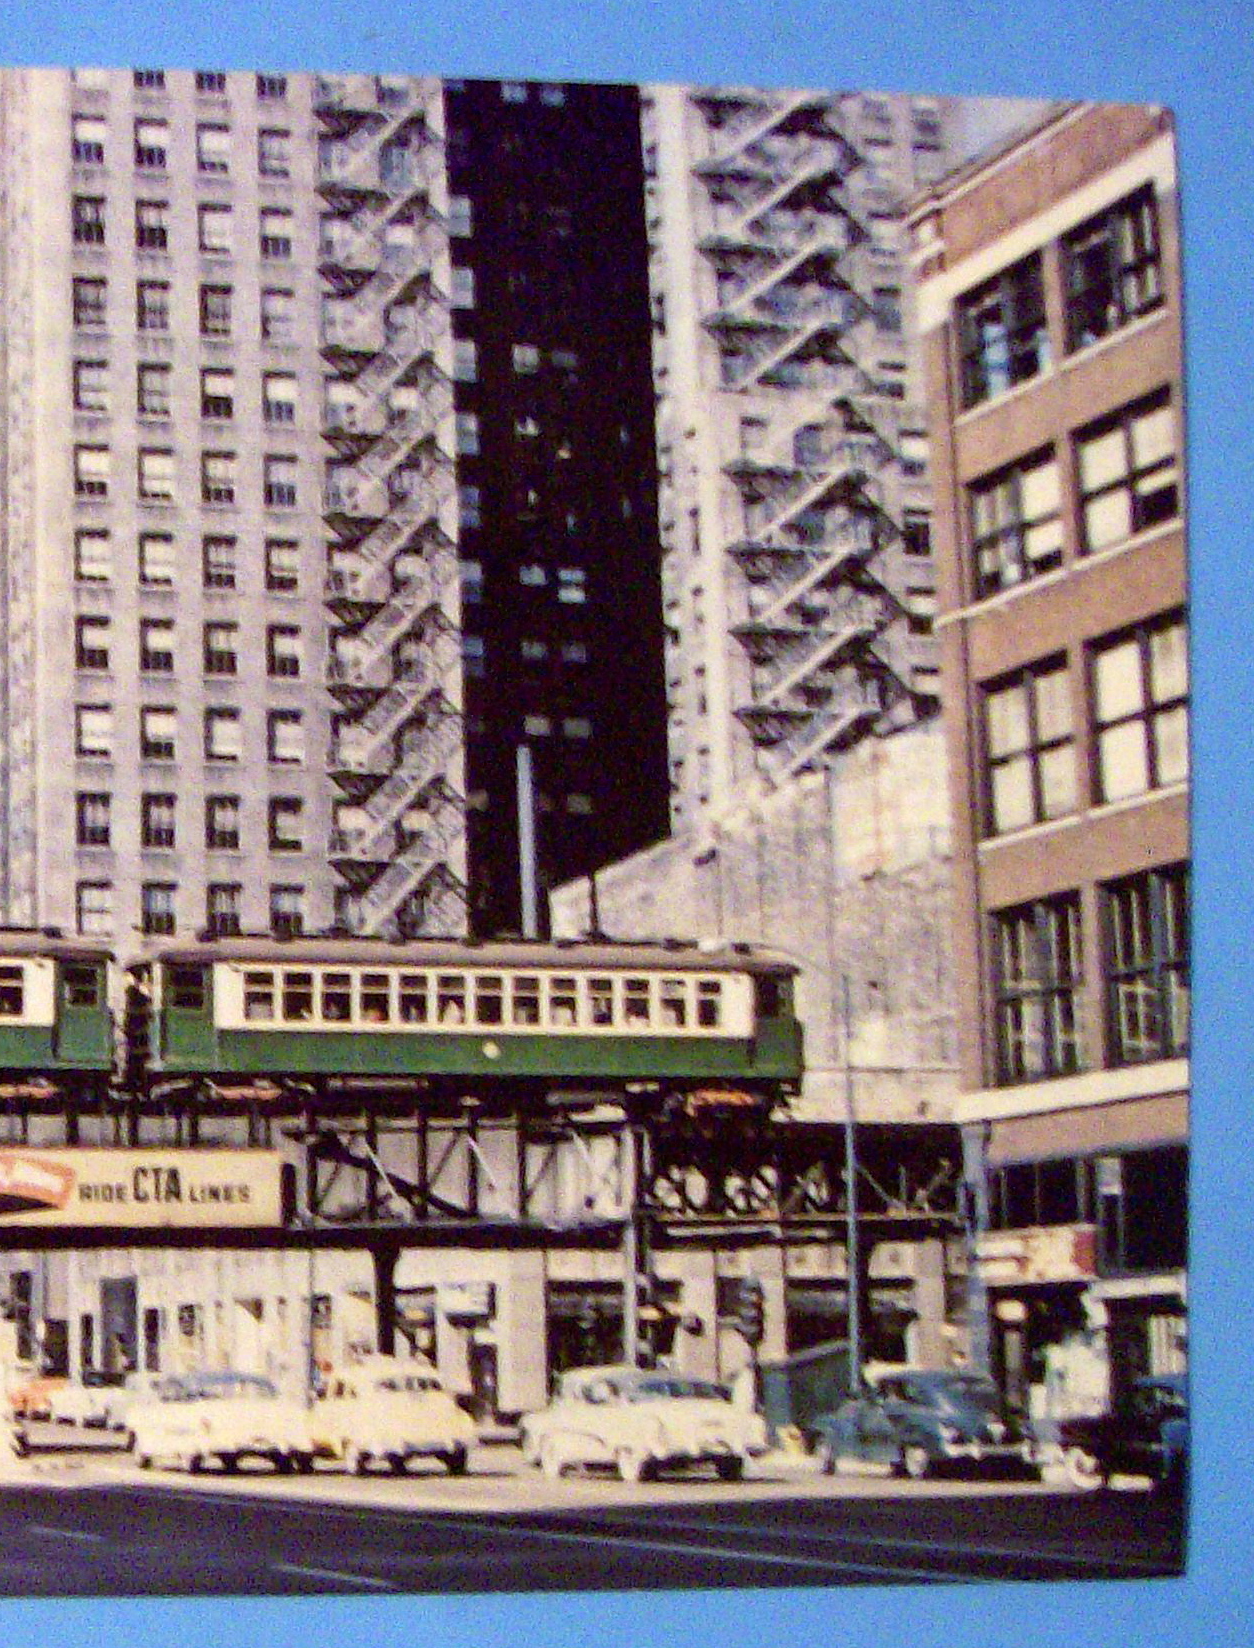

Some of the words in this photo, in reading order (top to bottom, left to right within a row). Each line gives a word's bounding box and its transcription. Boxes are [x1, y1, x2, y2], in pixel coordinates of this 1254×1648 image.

[78, 1183, 128, 1204] RIDE
[132, 1165, 182, 1204] CTA
[188, 1183, 251, 1204] LINES
